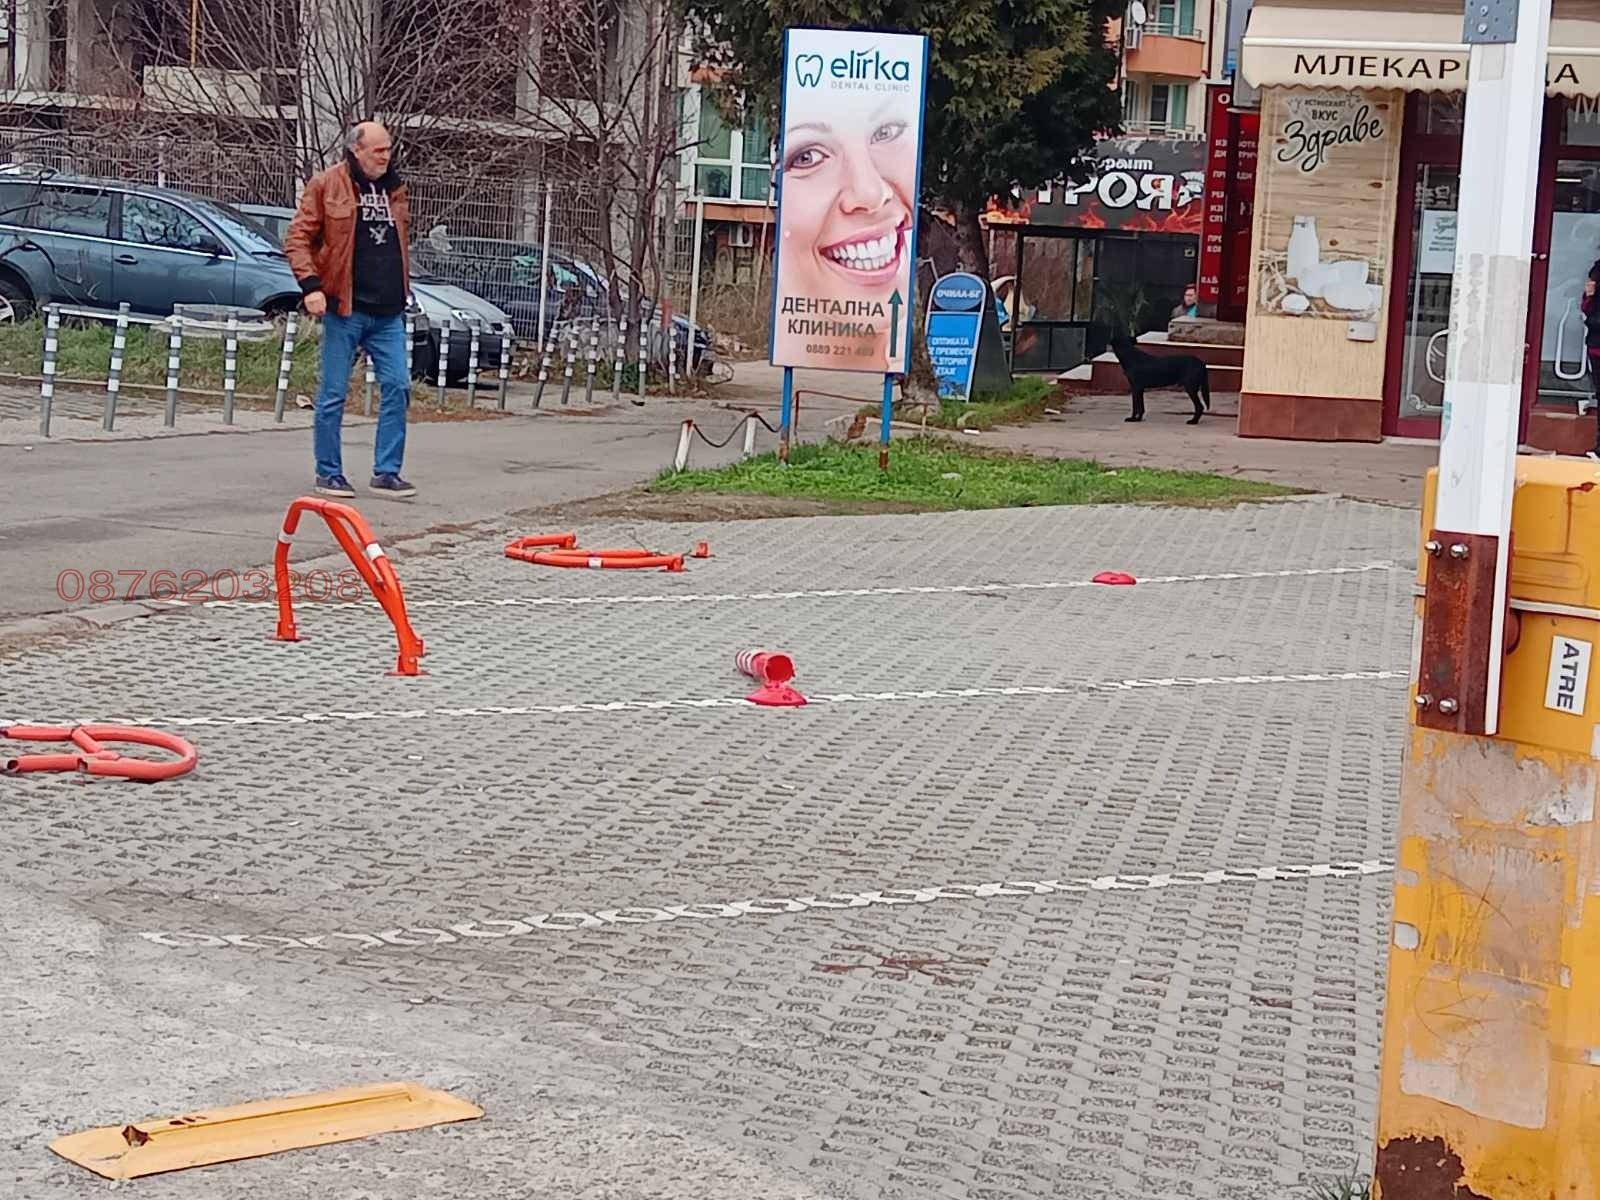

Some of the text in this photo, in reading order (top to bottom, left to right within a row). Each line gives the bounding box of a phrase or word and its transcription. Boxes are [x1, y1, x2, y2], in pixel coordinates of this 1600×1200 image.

[830, 47, 910, 81] elirka
[831, 81, 911, 93] DENTAL CLINIC
[1311, 109, 1339, 121] ВКУС
[1277, 104, 1384, 172] Здраве
[781, 296, 885, 318] ДЕНТАЛНА
[787, 319, 877, 338] КЛИНИКА
[1556, 641, 1580, 710] ATRE
